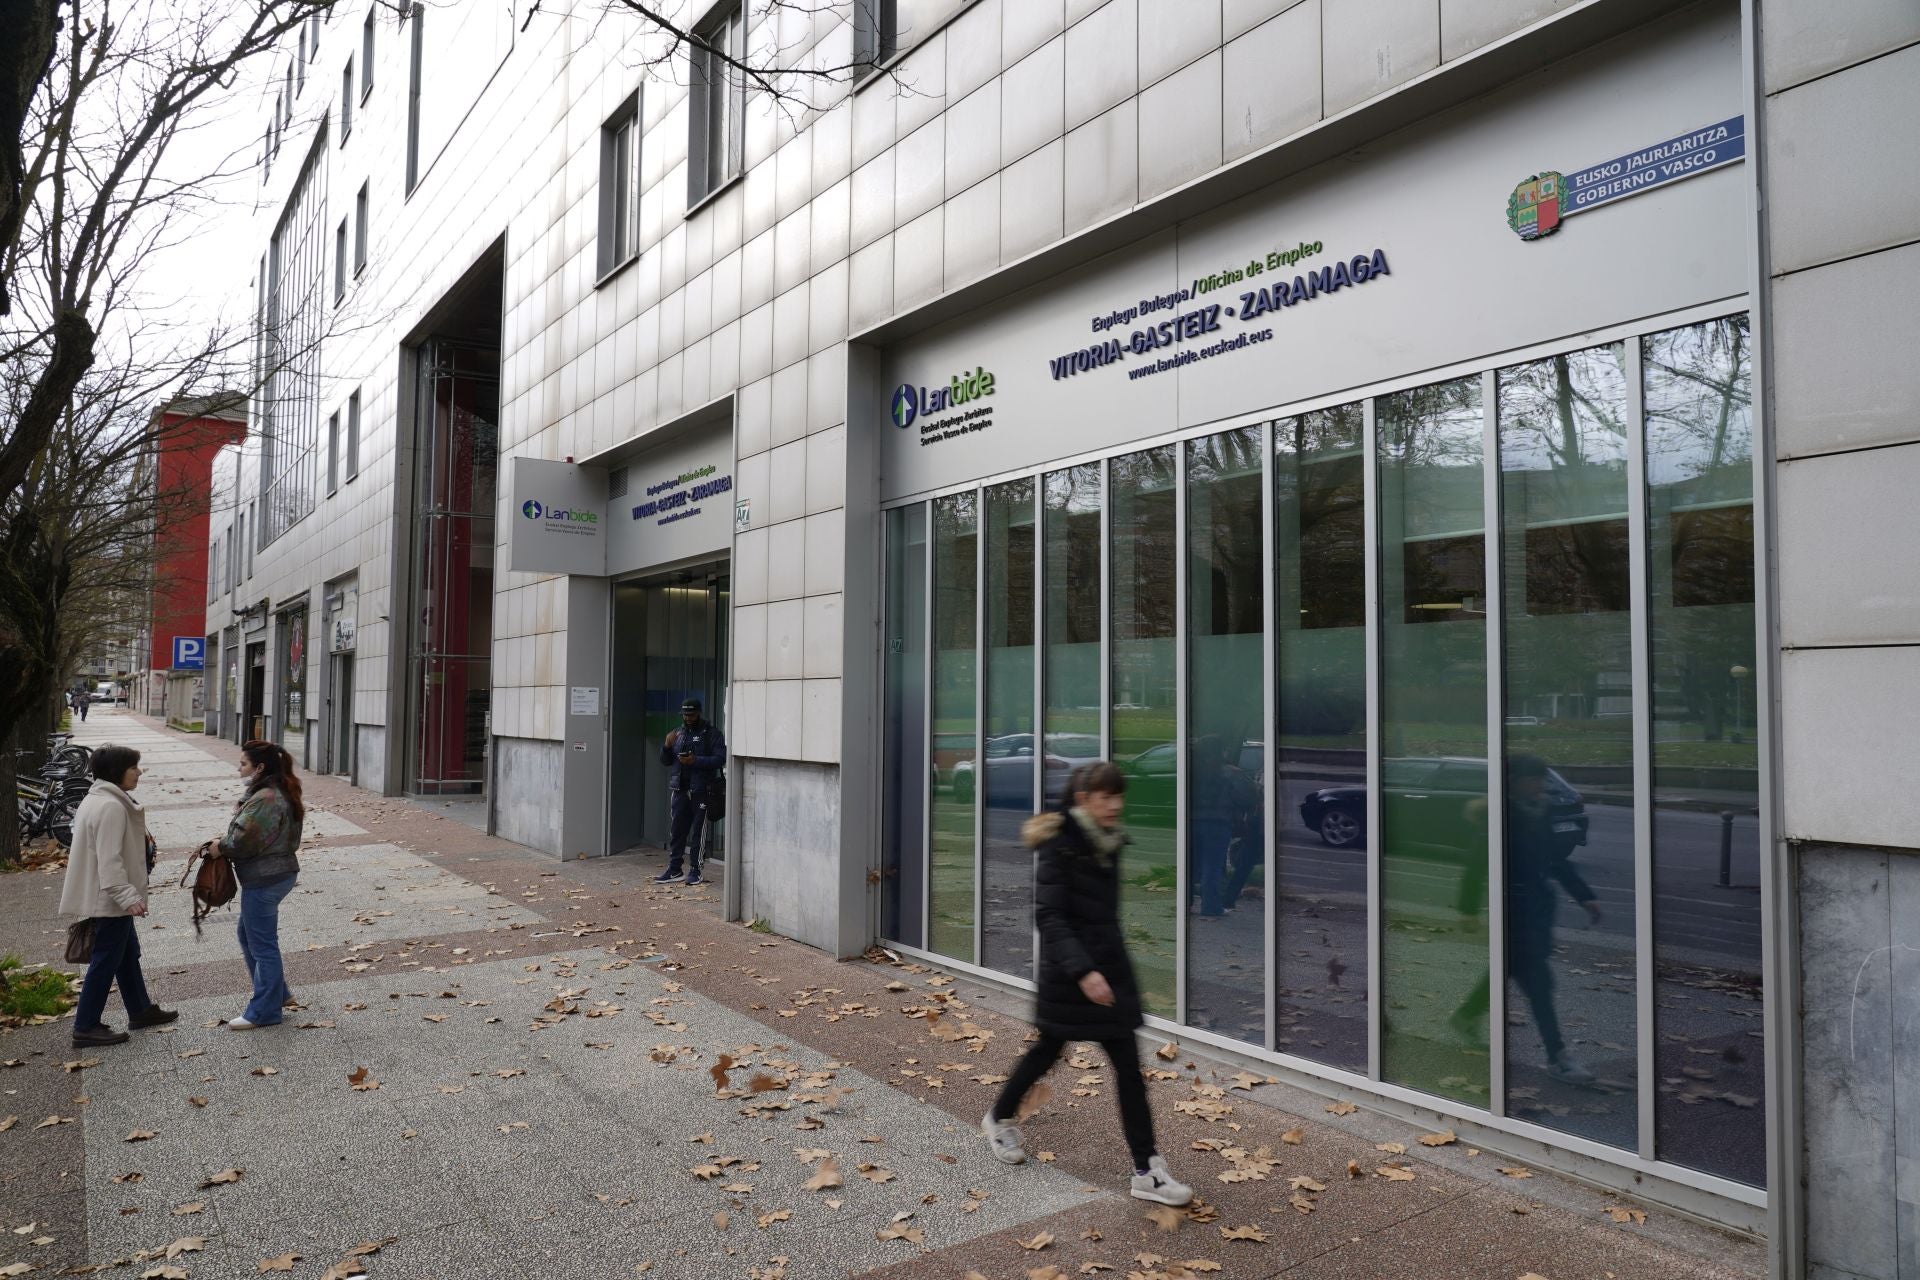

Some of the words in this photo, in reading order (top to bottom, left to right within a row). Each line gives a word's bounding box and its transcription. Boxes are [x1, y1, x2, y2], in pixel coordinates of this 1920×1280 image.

[1575, 163, 1621, 187] EUSKO
[1625, 126, 1728, 173] JAURLARITZA
[1576, 169, 1657, 205] GOBIERNO
[1661, 149, 1716, 176] VASCO
[1092, 306, 1137, 332] Enplegu
[1246, 260, 1263, 278] de
[1266, 240, 1323, 271] Empleo
[1049, 303, 1222, 381] VITORIA-GASTEIZ
[1239, 248, 1391, 321] ZARAMAGA
[1128, 327, 1273, 381] www.lanbide.euskadi.eus
[920, 366, 995, 416] Lanbide
[545, 505, 598, 523] Lanbide
[691, 475, 733, 502] ZARAMAGA
[179, 639, 200, 663] P
